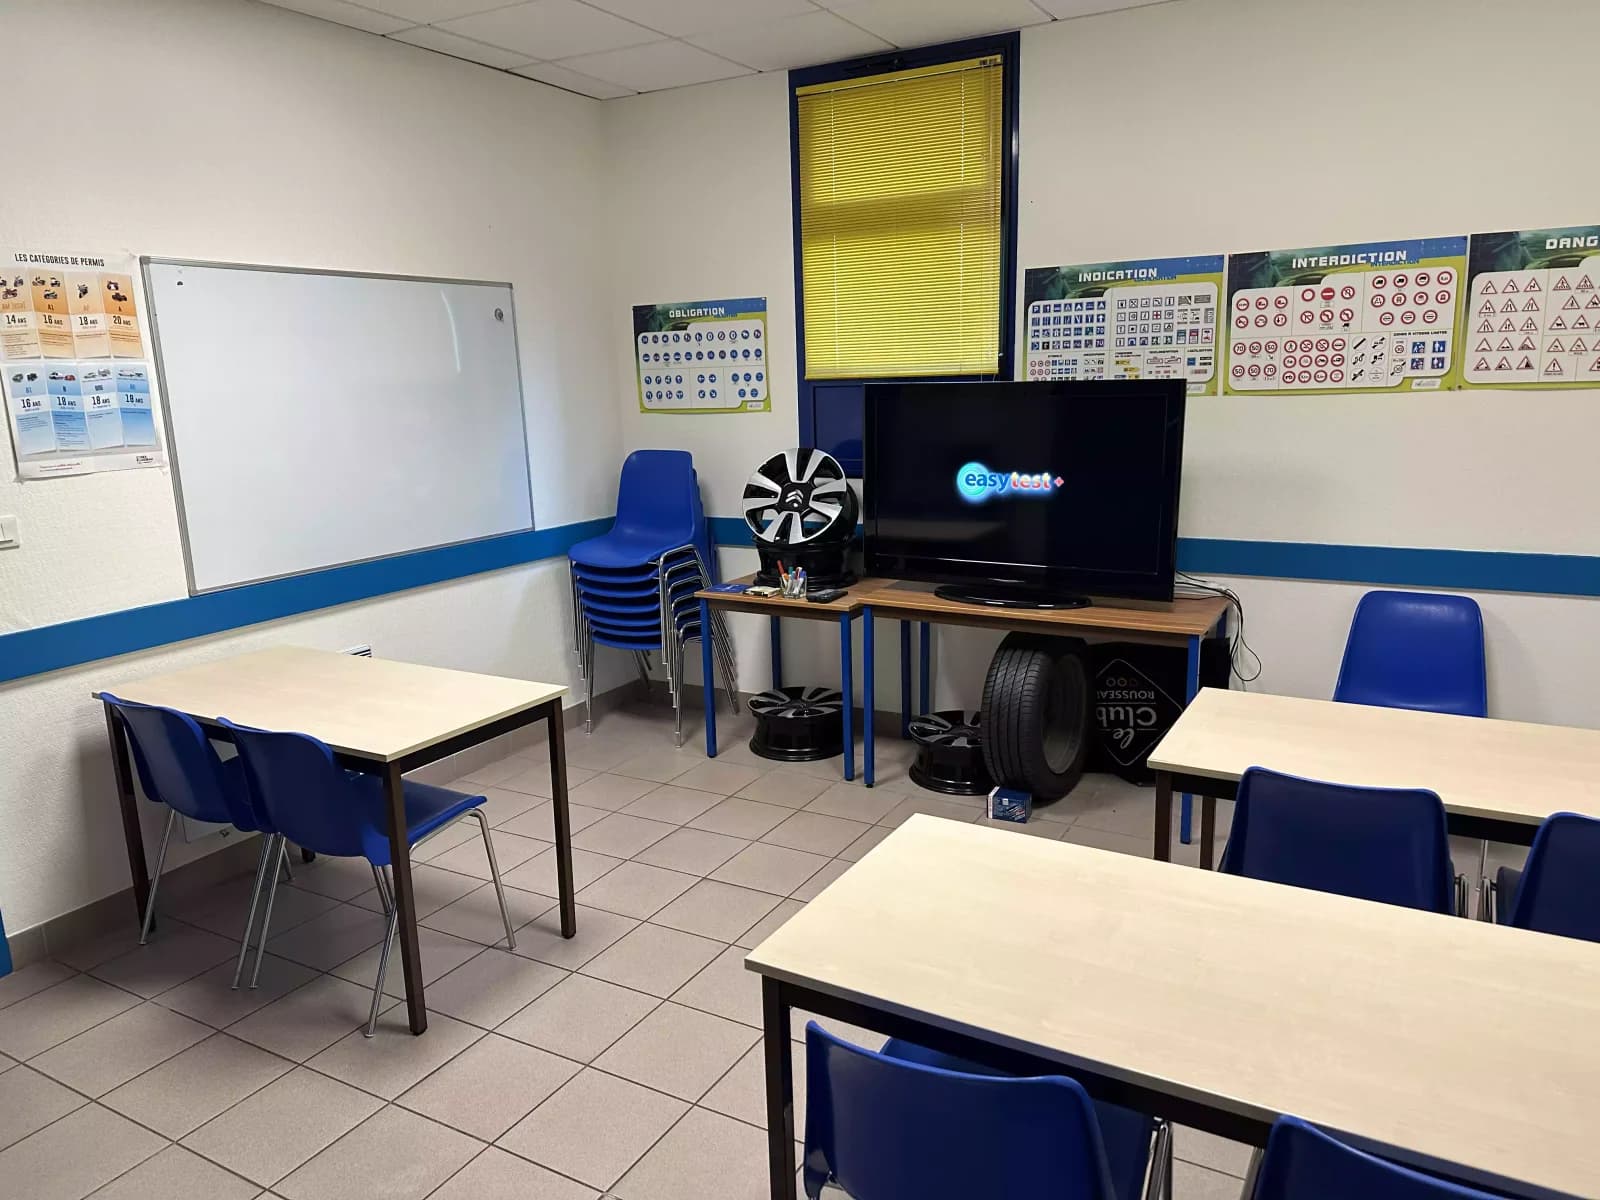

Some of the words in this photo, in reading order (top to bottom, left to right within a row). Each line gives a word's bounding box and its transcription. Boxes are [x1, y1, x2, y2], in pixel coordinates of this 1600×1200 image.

[14, 253, 28, 262] LES
[70, 256, 79, 265] DE
[80, 257, 105, 267] PERMIS
[1292, 250, 1407, 269] INTERDICTION
[1078, 267, 1158, 282] INDICATION
[669, 306, 725, 318] OBLIGATION
[6, 314, 16, 324] 14
[43, 314, 53, 325] 16
[79, 316, 89, 326] 18
[112, 315, 122, 325] 20
[21, 399, 31, 408] 16
[56, 396, 67, 406] 18
[91, 395, 101, 405] 18
[125, 394, 134, 403] 18
[1096, 706, 1157, 728] Club
